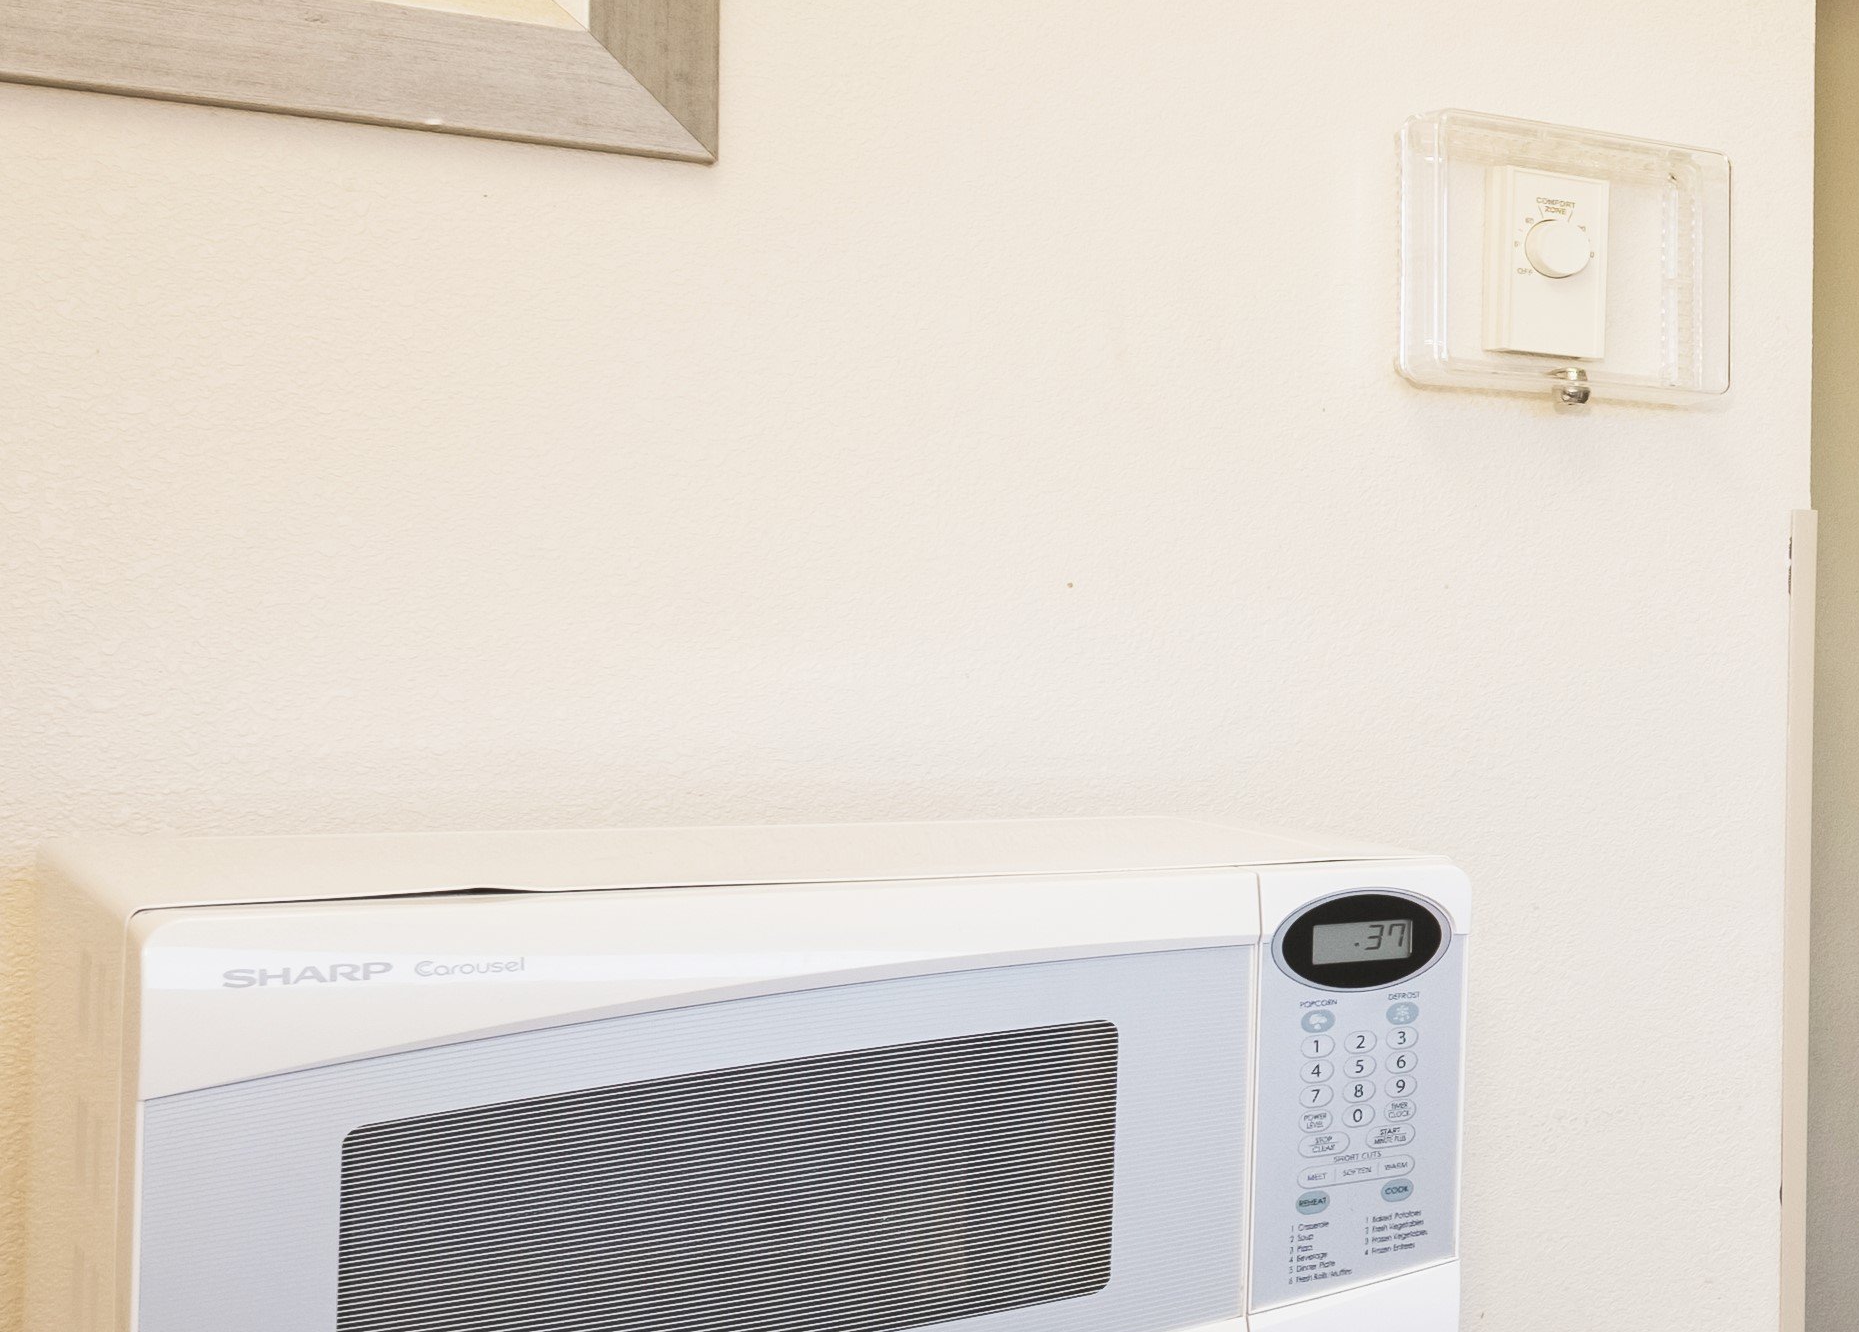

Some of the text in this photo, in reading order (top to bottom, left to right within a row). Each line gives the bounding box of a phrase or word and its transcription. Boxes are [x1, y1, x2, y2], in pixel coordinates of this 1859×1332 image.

[222, 957, 525, 988] SHARP Carousel
[1299, 999, 1338, 1008] POPCORN
[1388, 991, 1421, 1001] DEFROST
[1313, 1030, 1406, 1053] 1 2 3
[1311, 1055, 1406, 1077] 4 5 6
[1311, 1079, 1406, 1103] 7 8 9
[1352, 1108, 1363, 1123] 0
